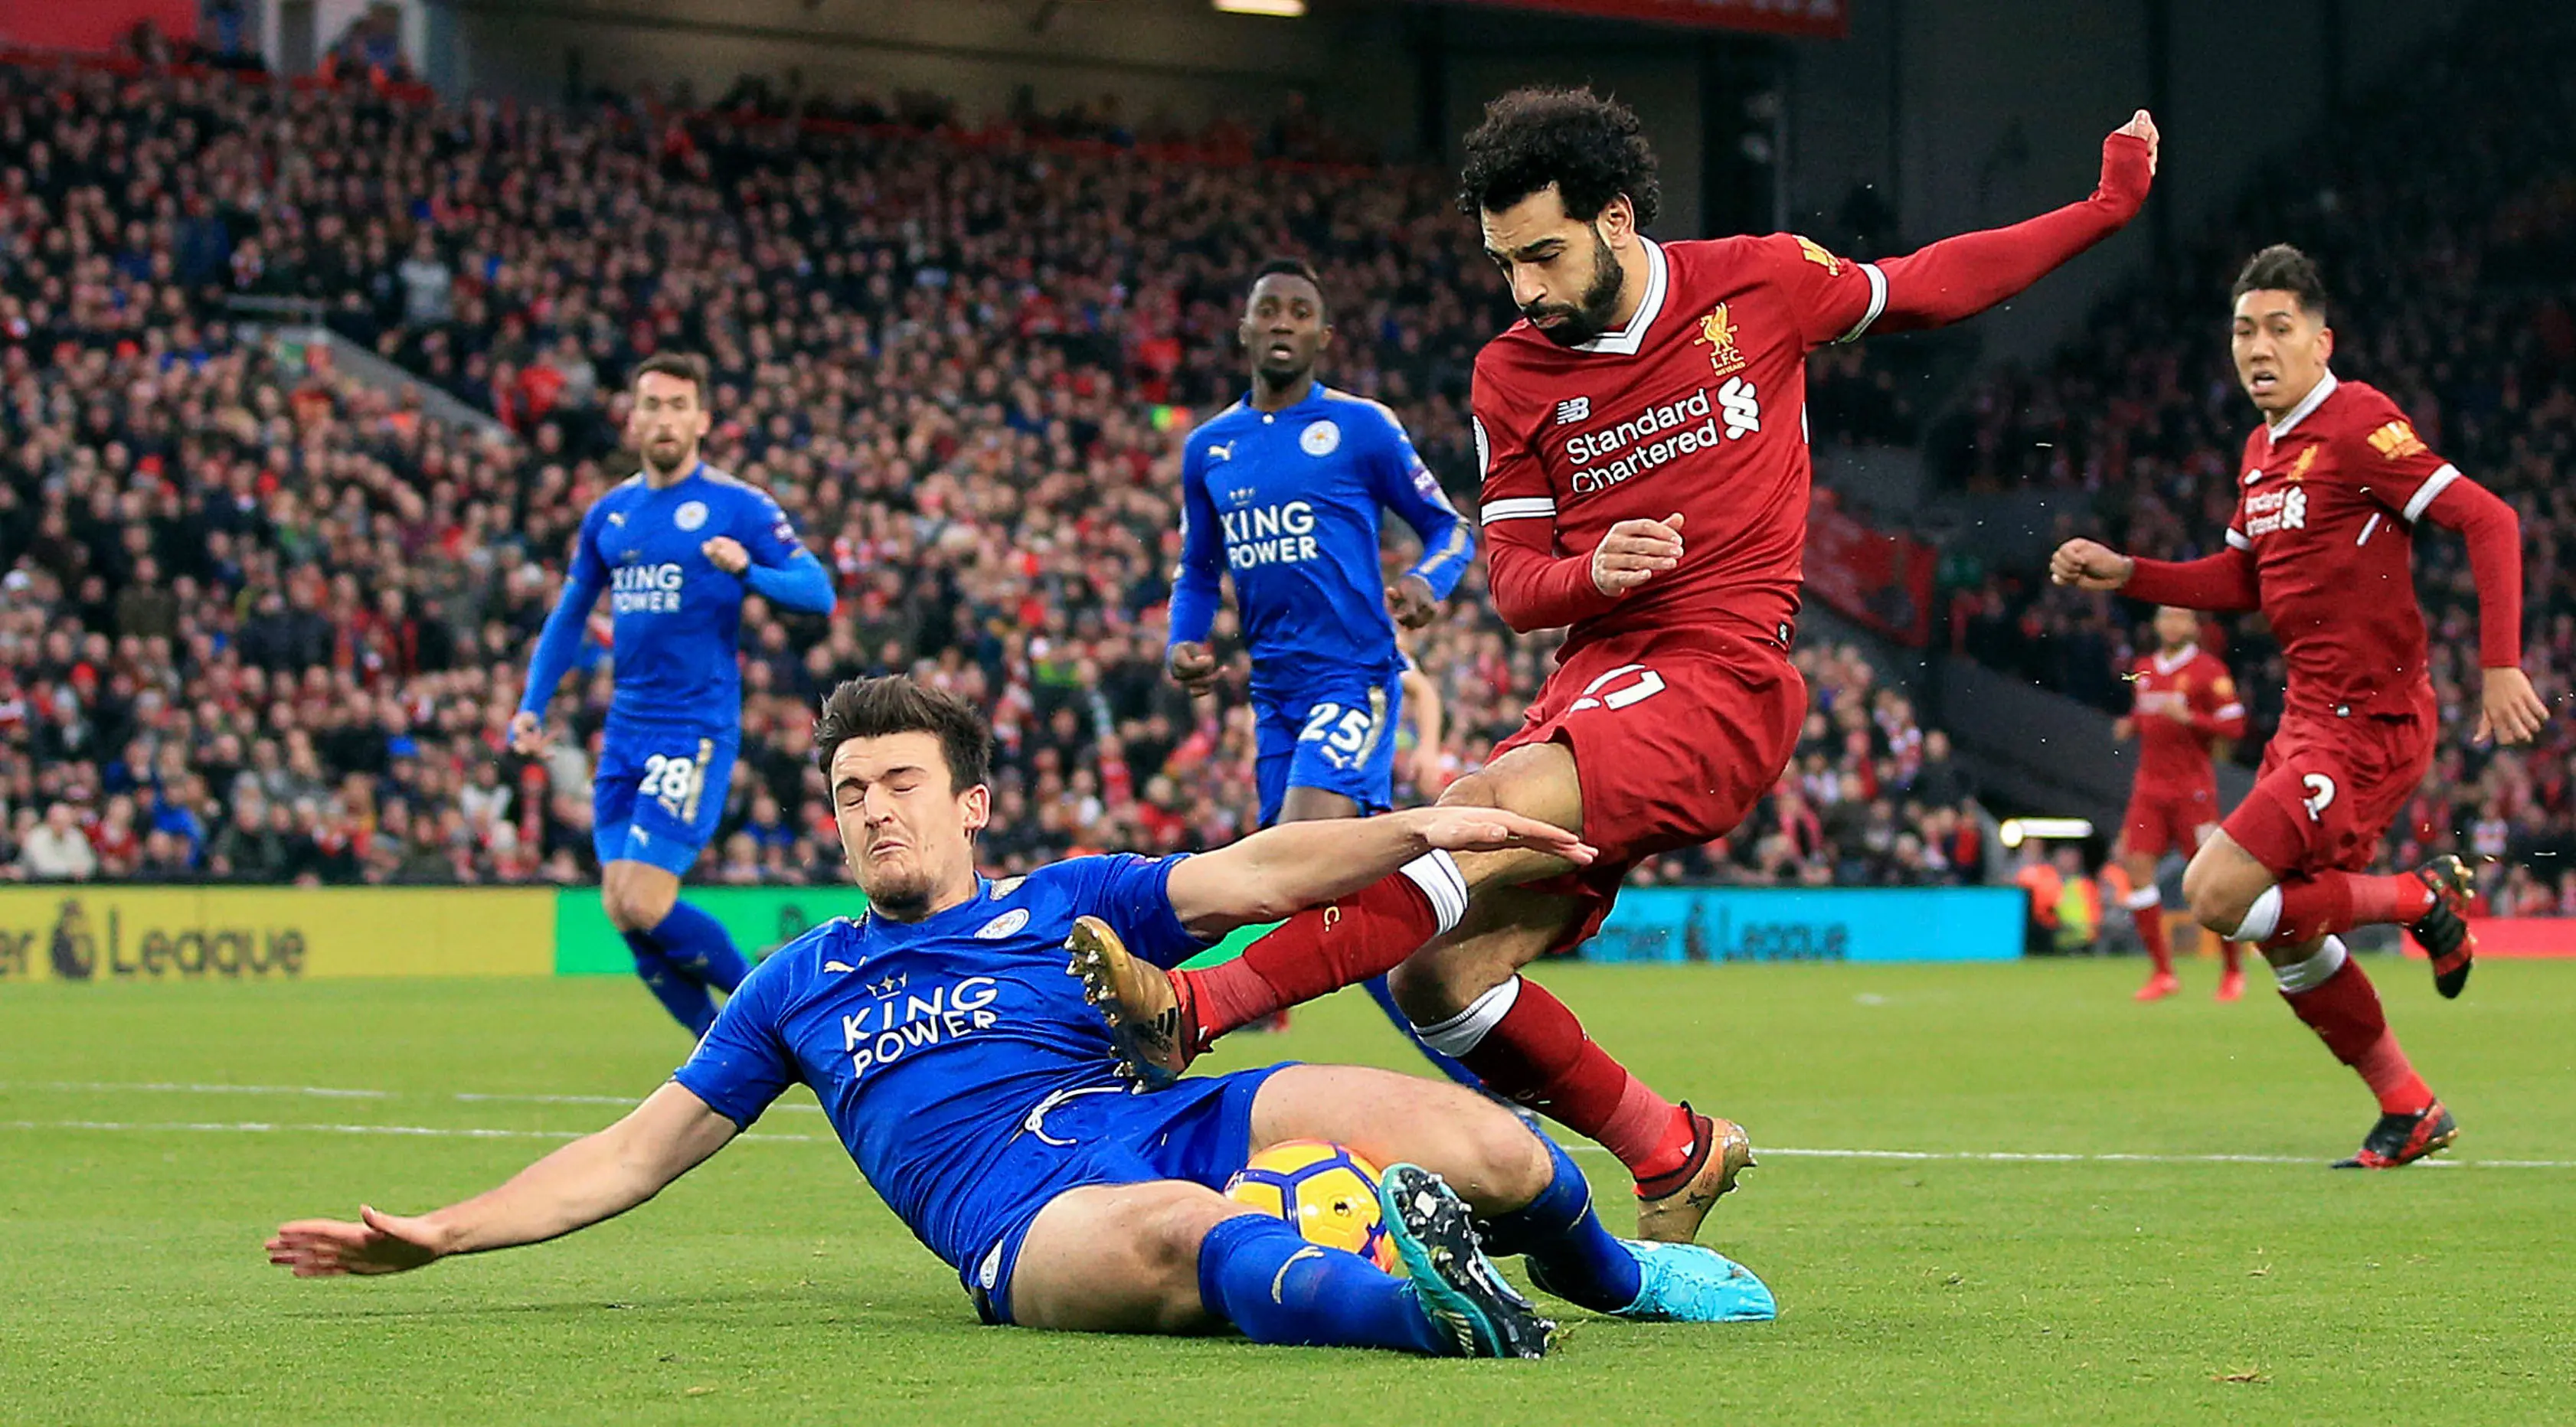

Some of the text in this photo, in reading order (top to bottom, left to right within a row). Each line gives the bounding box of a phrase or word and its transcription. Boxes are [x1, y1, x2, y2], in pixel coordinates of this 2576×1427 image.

[1567, 388, 1711, 465] Standard
[1572, 419, 1718, 493] Chartered
[1221, 500, 1315, 545] KING
[1229, 536, 1318, 570] POWER
[612, 563, 684, 593] KING
[612, 591, 682, 613] POWER
[1299, 703, 1371, 752] 25
[638, 753, 695, 798] 28
[108, 903, 306, 976] League
[843, 977, 998, 1052] KING
[851, 1010, 997, 1078] POWER
